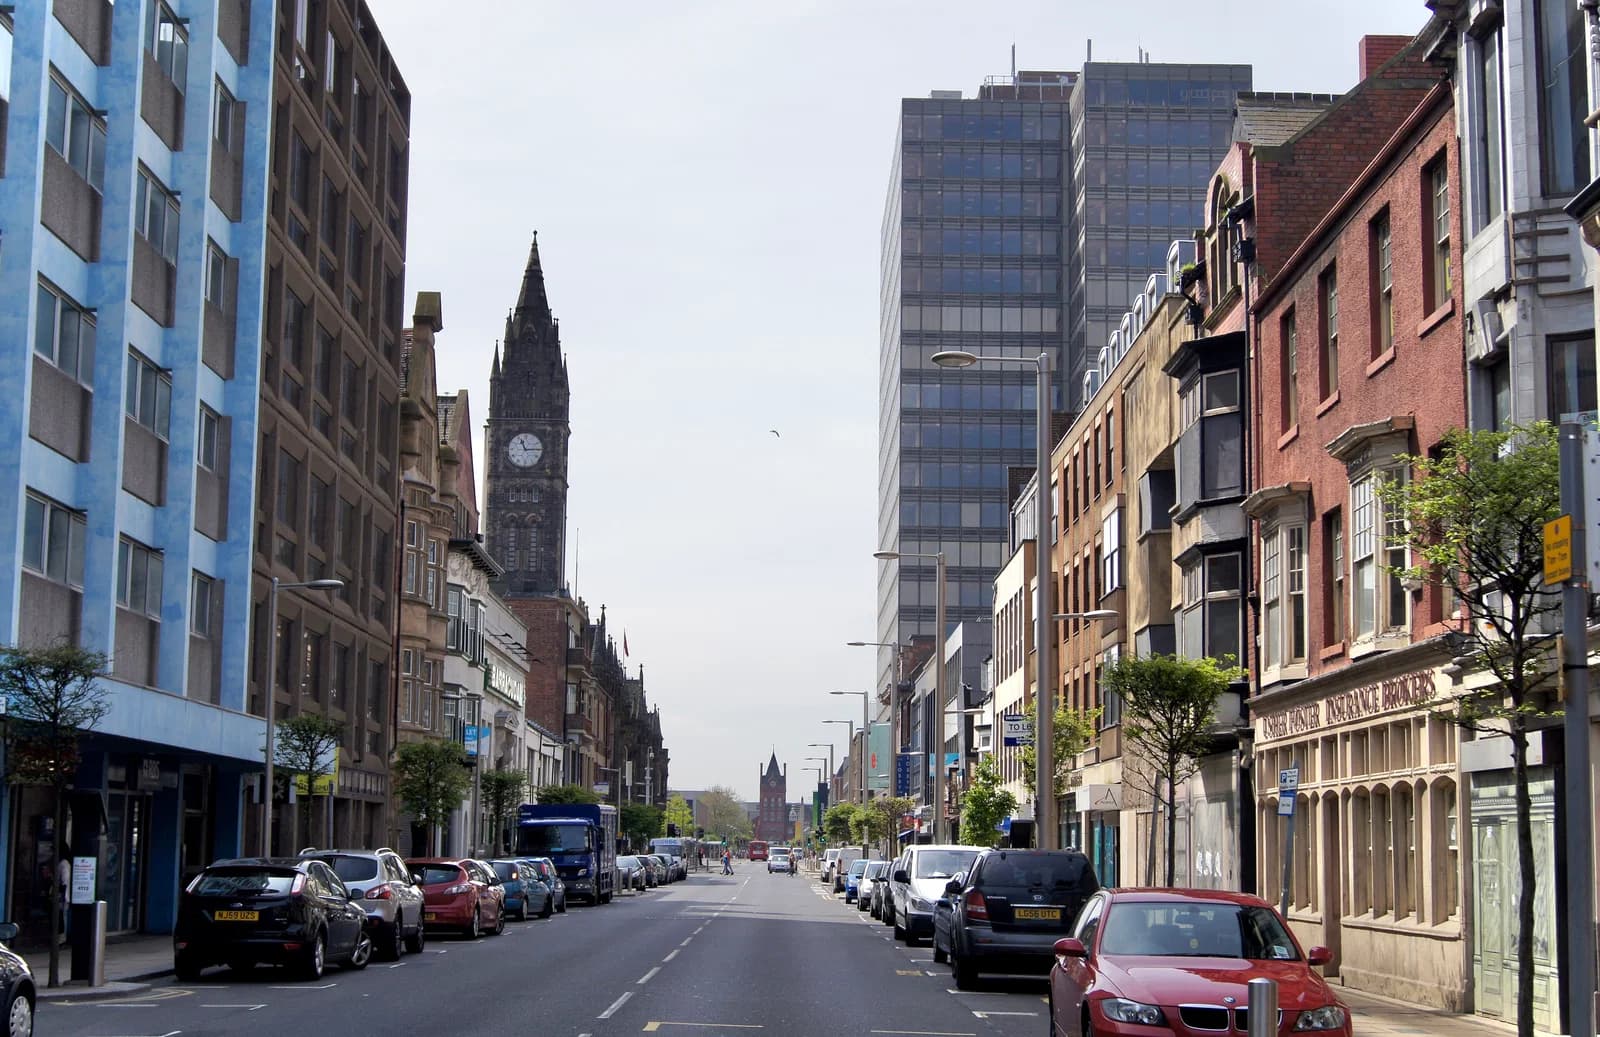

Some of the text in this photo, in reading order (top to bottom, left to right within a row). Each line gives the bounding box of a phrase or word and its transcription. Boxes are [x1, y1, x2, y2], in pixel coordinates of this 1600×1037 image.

[1289, 704, 1321, 734] FOSTER
[1325, 686, 1380, 725] INSURANCE
[1381, 670, 1437, 710] BROKERS
[241, 911, 256, 920] UZS
[1041, 909, 1057, 918] UTC
